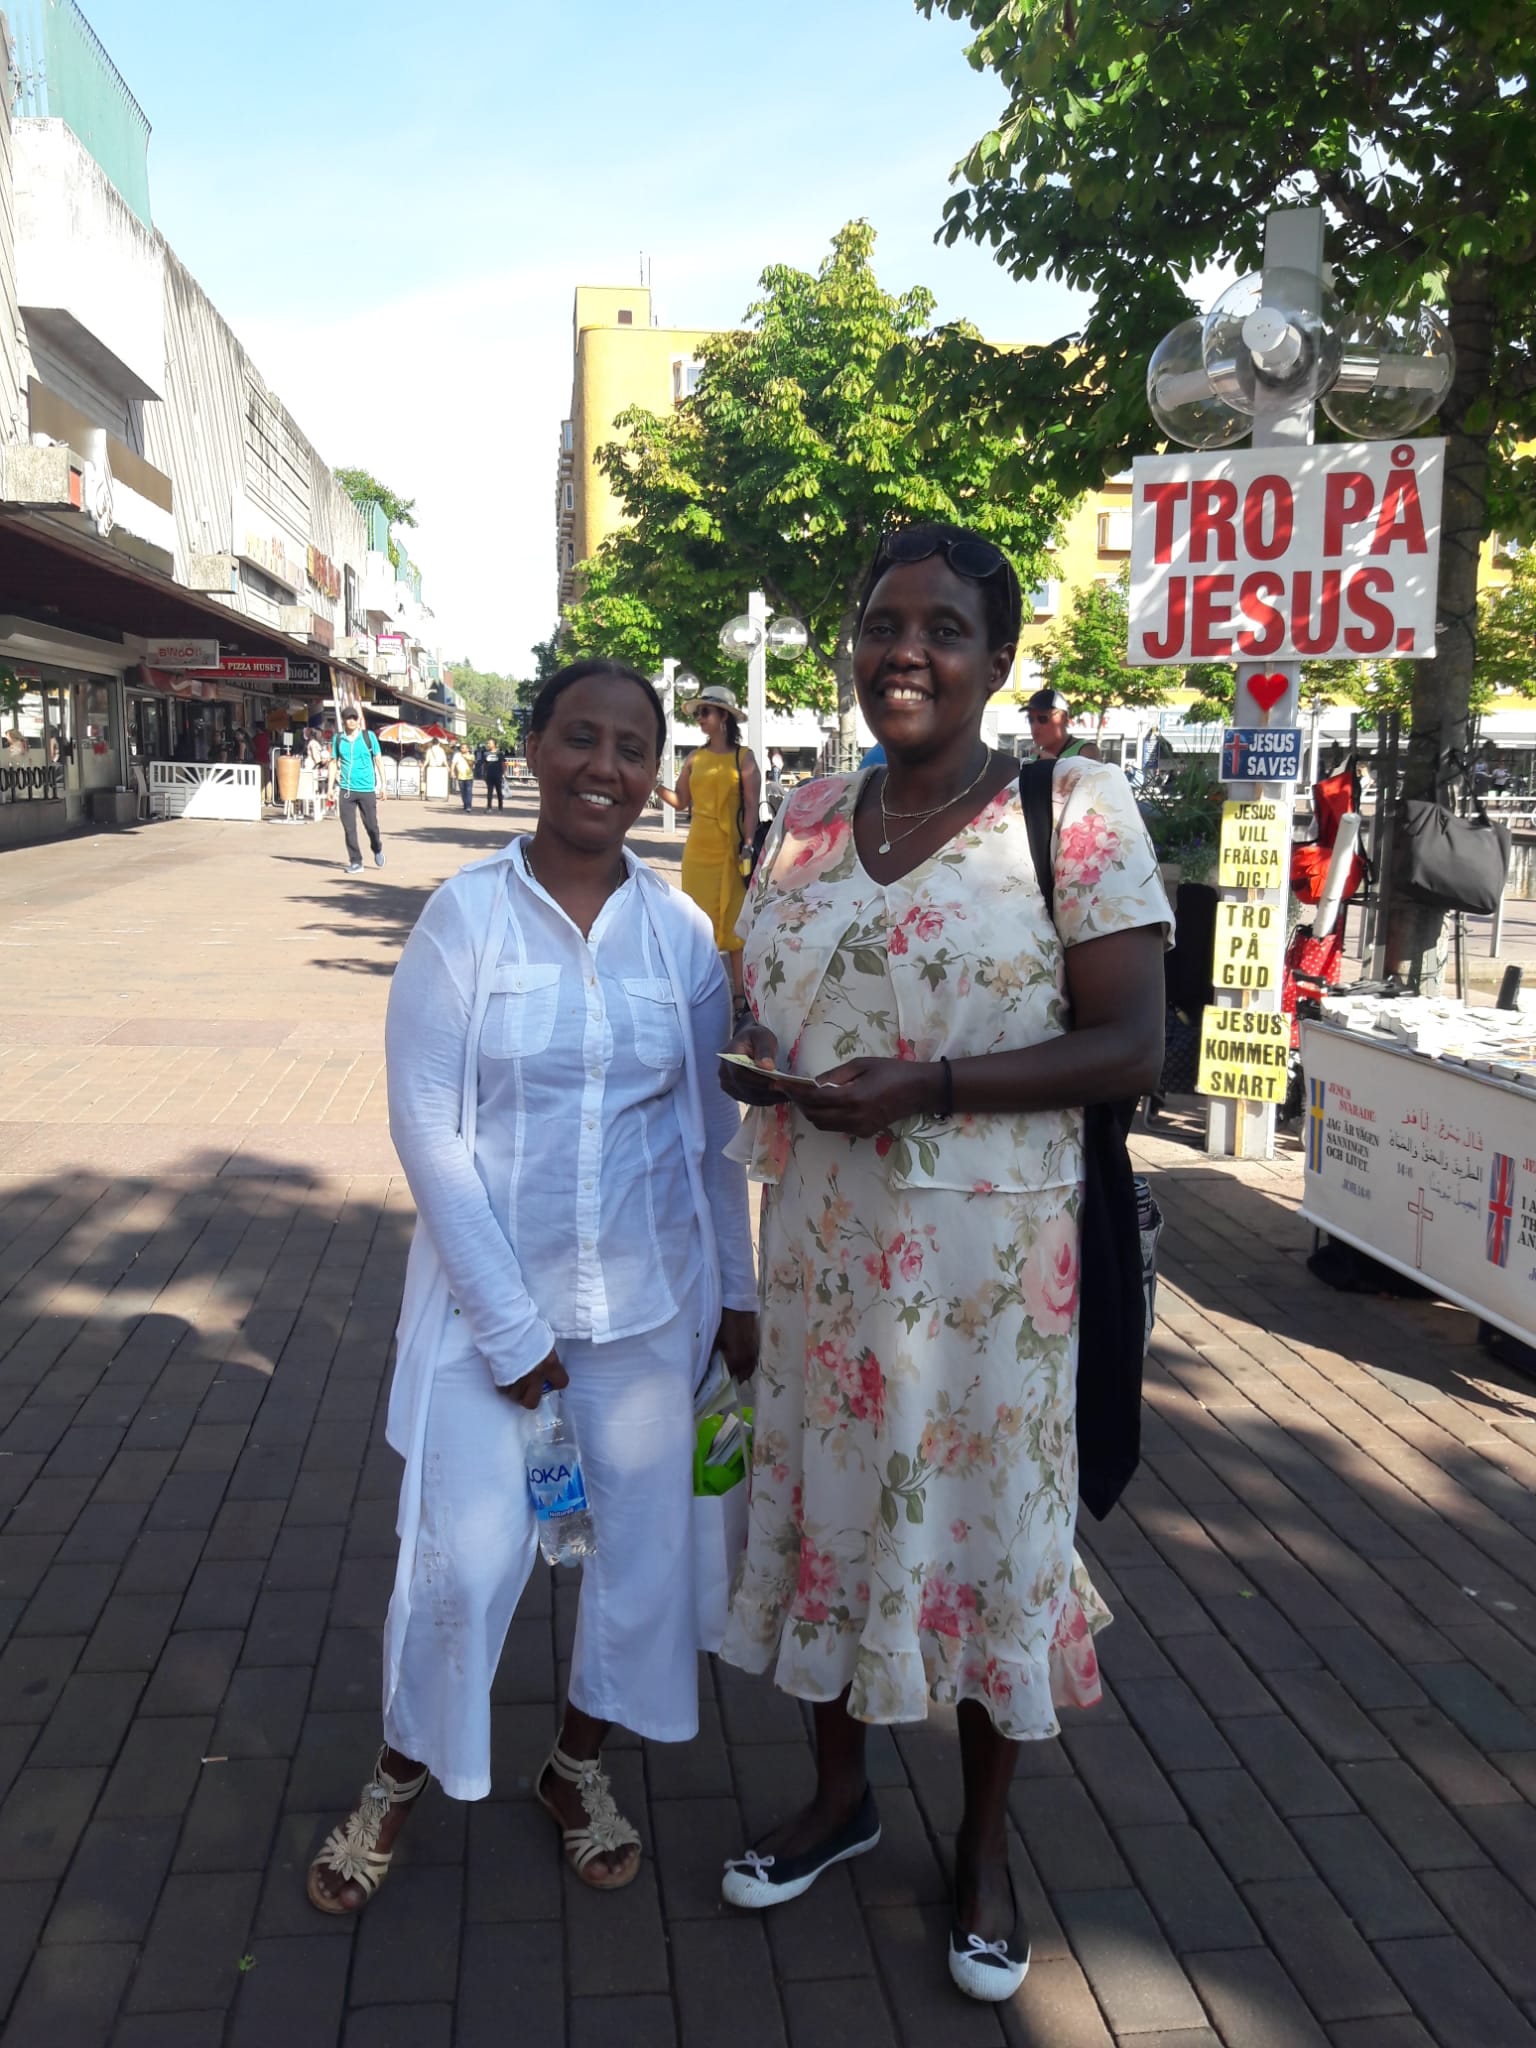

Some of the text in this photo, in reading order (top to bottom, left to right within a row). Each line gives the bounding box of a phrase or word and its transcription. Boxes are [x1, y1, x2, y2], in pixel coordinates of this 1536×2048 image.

[1143, 443, 1428, 565] TRO PÅ
[1142, 566, 1415, 660] JESUS.
[227, 662, 251, 671] PIZZA
[253, 664, 282, 673] HUSET
[1249, 732, 1295, 753] JESUS
[1247, 756, 1297, 776] SAVES
[1234, 804, 1276, 820] JESUS
[1238, 825, 1269, 842] VILL
[1223, 846, 1279, 866] FRÄLSA
[1226, 904, 1271, 929] TRO
[1229, 932, 1260, 961] PÅ
[1222, 963, 1269, 988] GUD
[1216, 1009, 1283, 1036] JESUS
[1205, 1038, 1288, 1068] KOMMER
[1210, 1070, 1278, 1099] SNART
[1327, 1082, 1352, 1099] JESUS
[1326, 1117, 1341, 1132] JAG
[1343, 1119, 1355, 1137] ÄR
[1326, 1145, 1343, 1161] OCH
